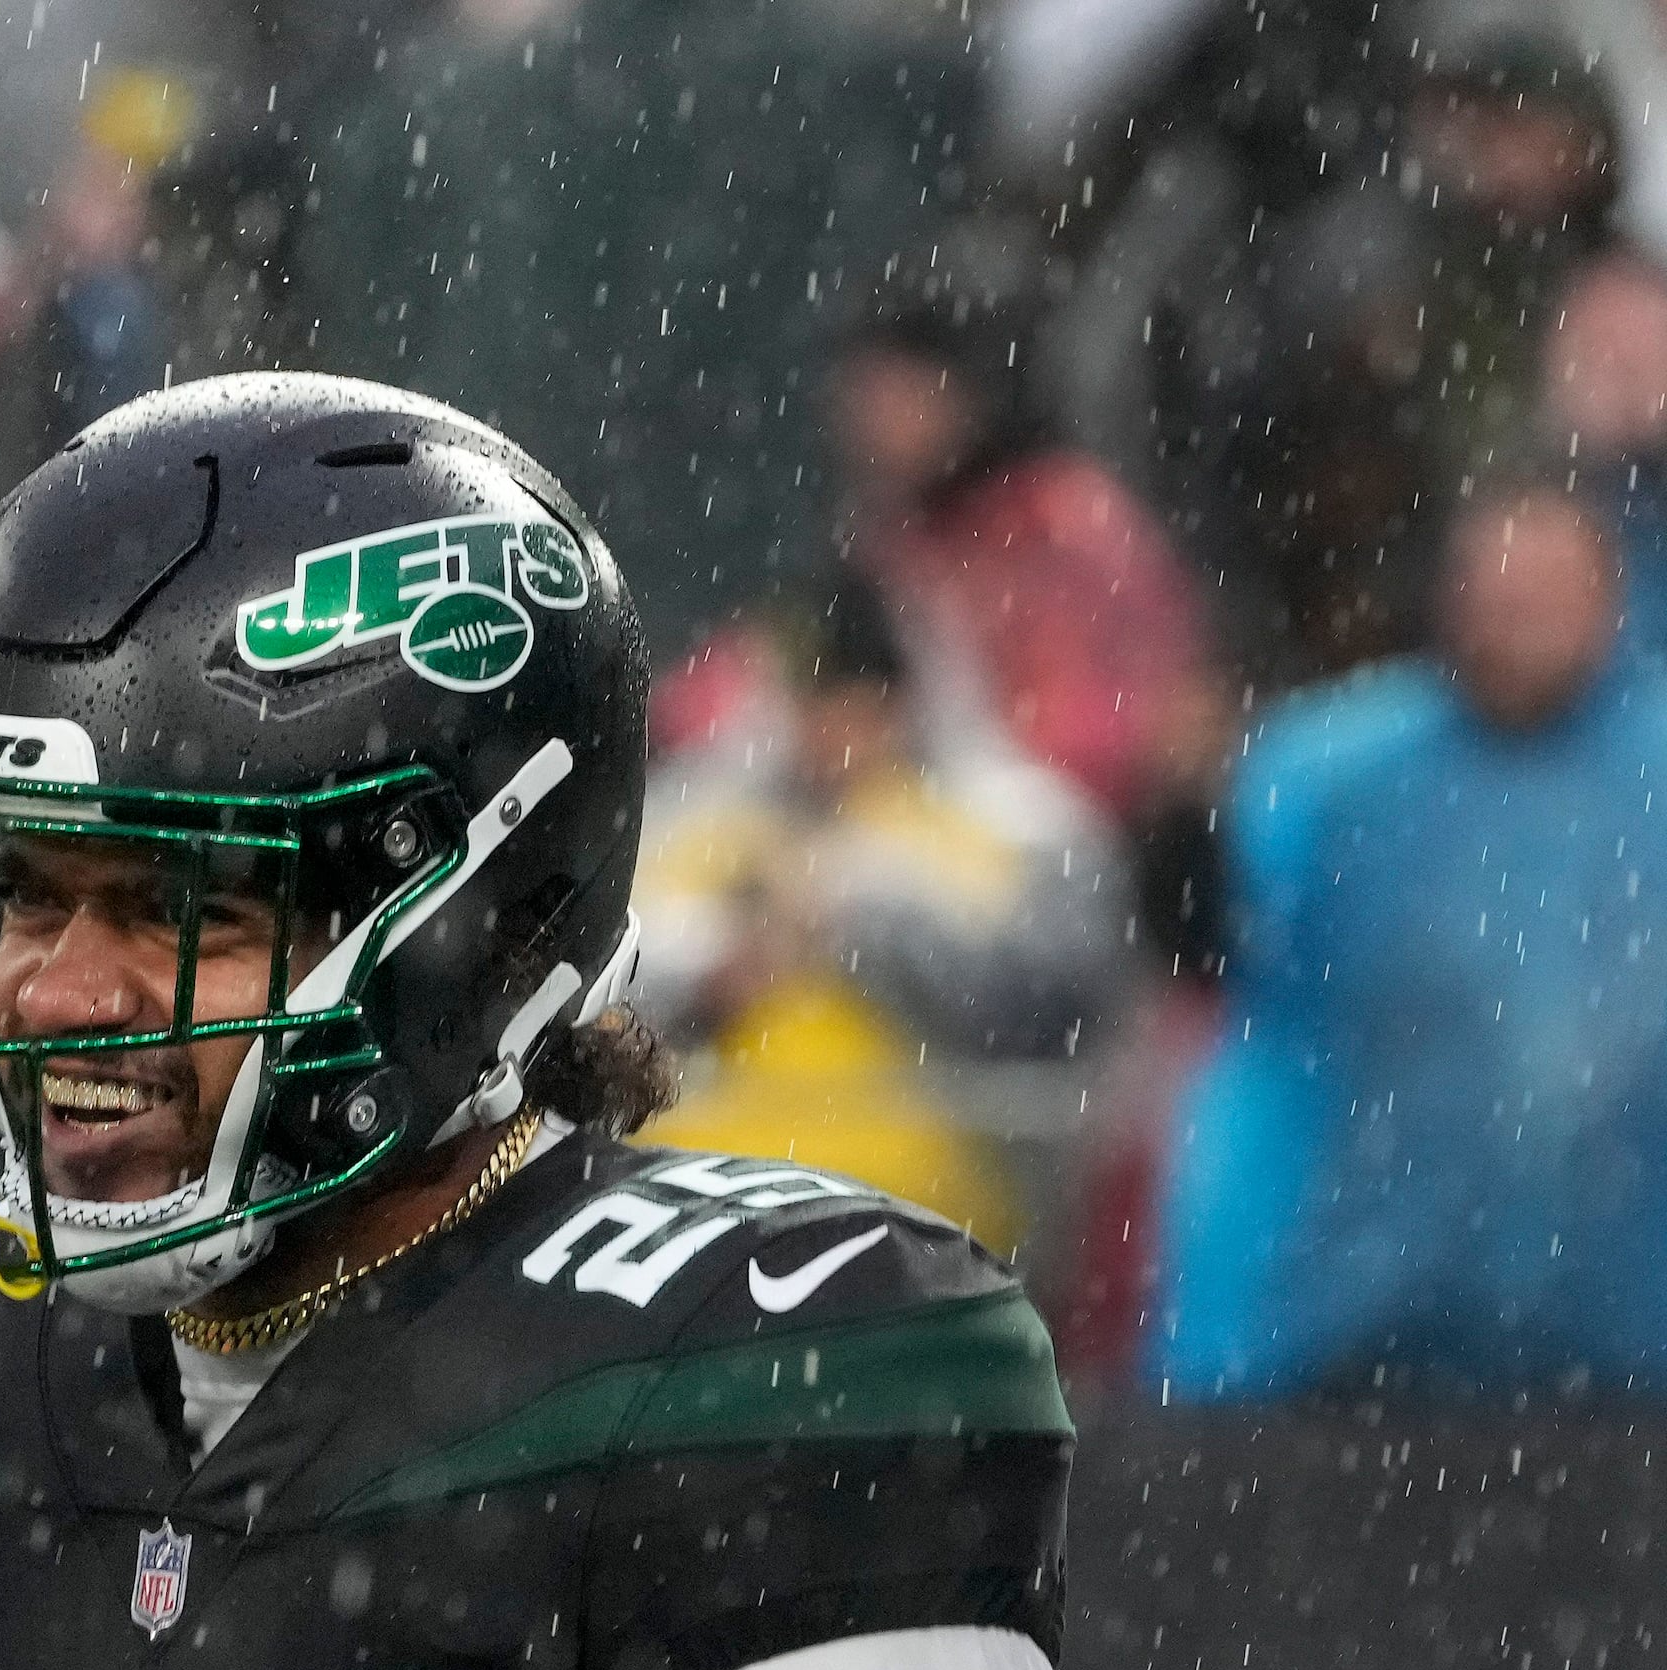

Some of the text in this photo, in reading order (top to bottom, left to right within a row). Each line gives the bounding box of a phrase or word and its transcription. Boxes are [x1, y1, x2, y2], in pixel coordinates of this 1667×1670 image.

[235, 511, 590, 675] JETS
[521, 1155, 859, 1310] 25
[137, 1572, 175, 1616] NFL
